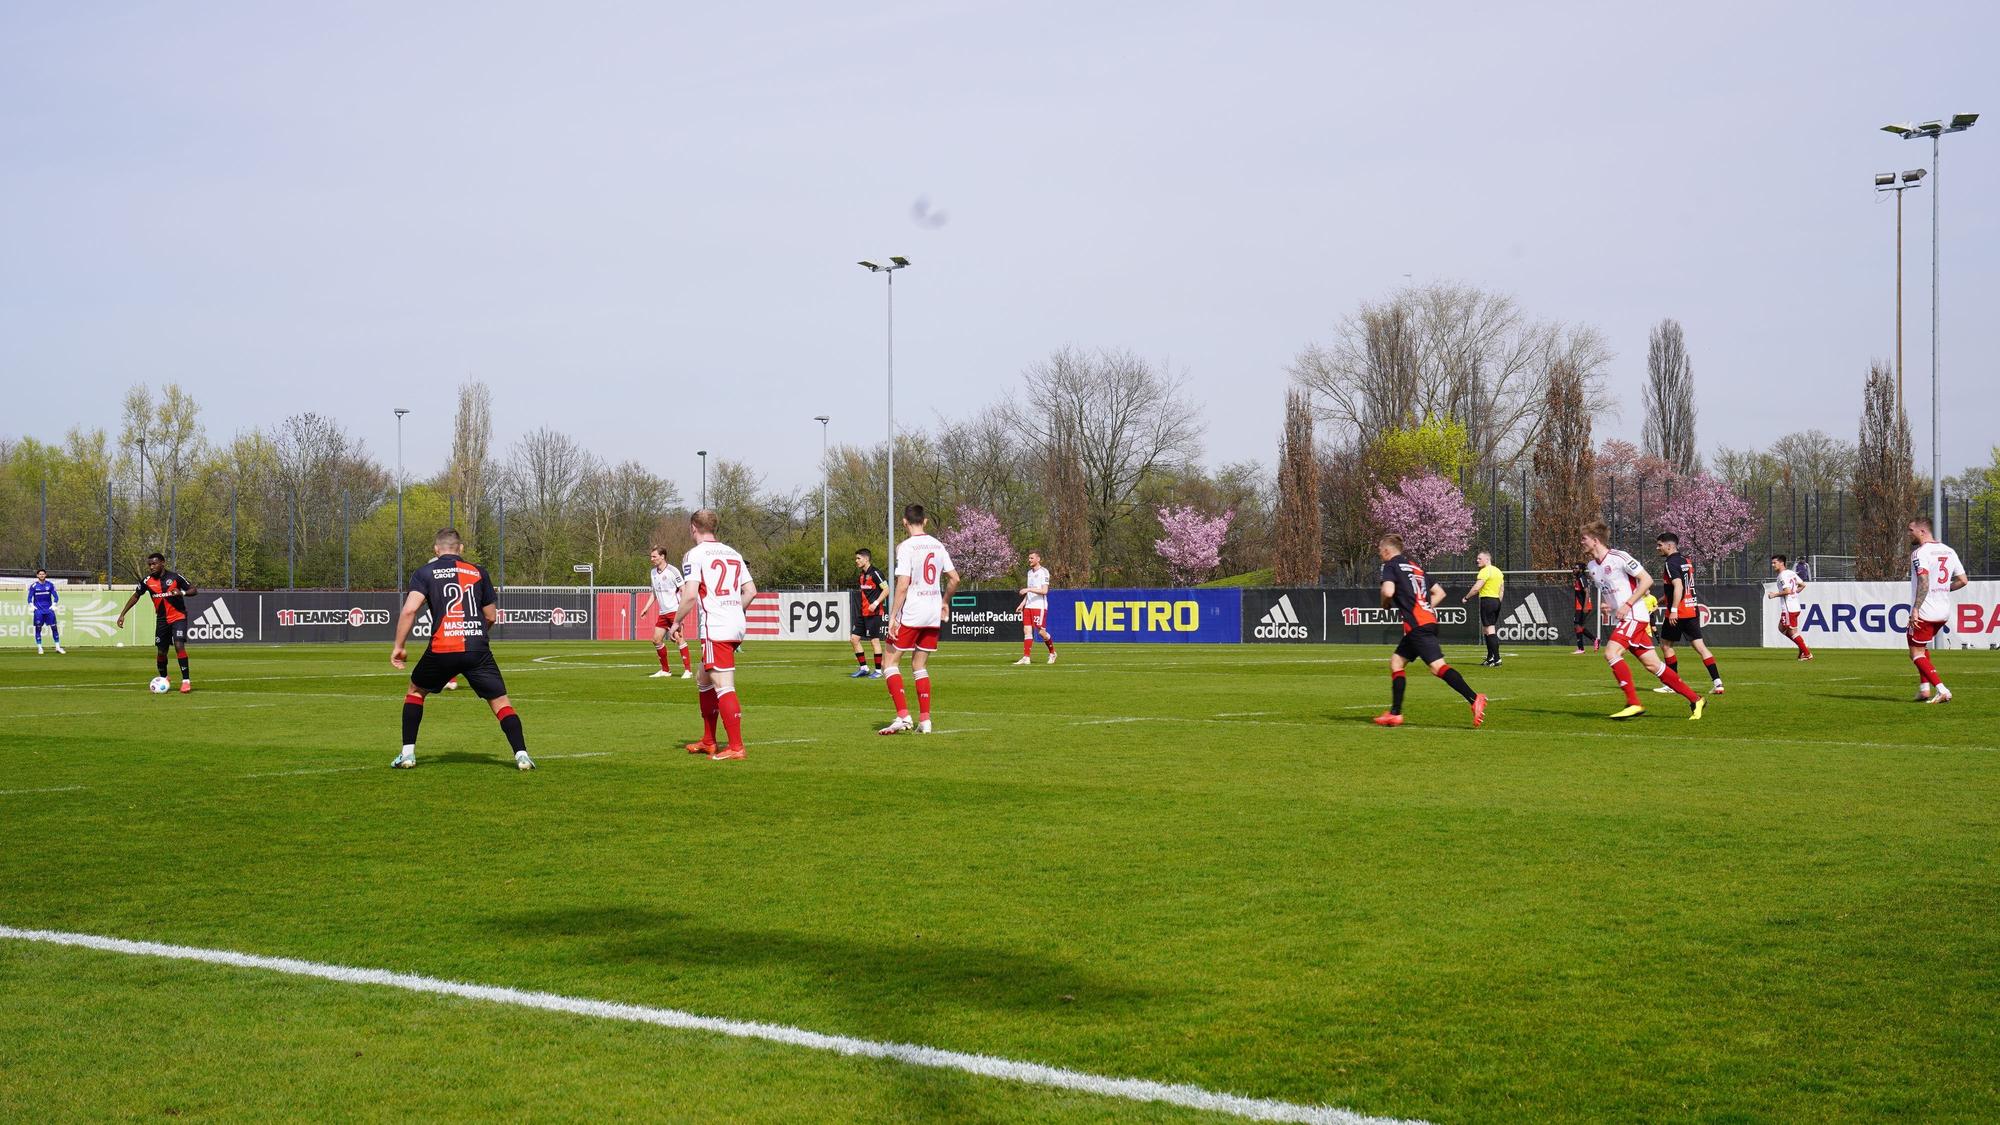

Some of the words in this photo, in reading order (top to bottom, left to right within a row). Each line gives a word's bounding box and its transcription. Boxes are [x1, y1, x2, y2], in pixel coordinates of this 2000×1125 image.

[710, 559, 741, 596] 27
[923, 552, 936, 585] 6
[1937, 557, 1949, 584] 3
[443, 582, 478, 618] 21
[276, 607, 391, 627] 11TEAMSPORTS
[494, 607, 588, 626] 1TEAMSPORTS
[789, 600, 840, 633] F95
[951, 611, 985, 622] Hewlett
[986, 611, 1023, 622] Packard
[1075, 601, 1199, 632] METRO
[186, 623, 244, 640] adidas
[951, 624, 995, 636] Enterprise
[1254, 622, 1308, 639] adidas
[1497, 623, 1559, 640] adidas
